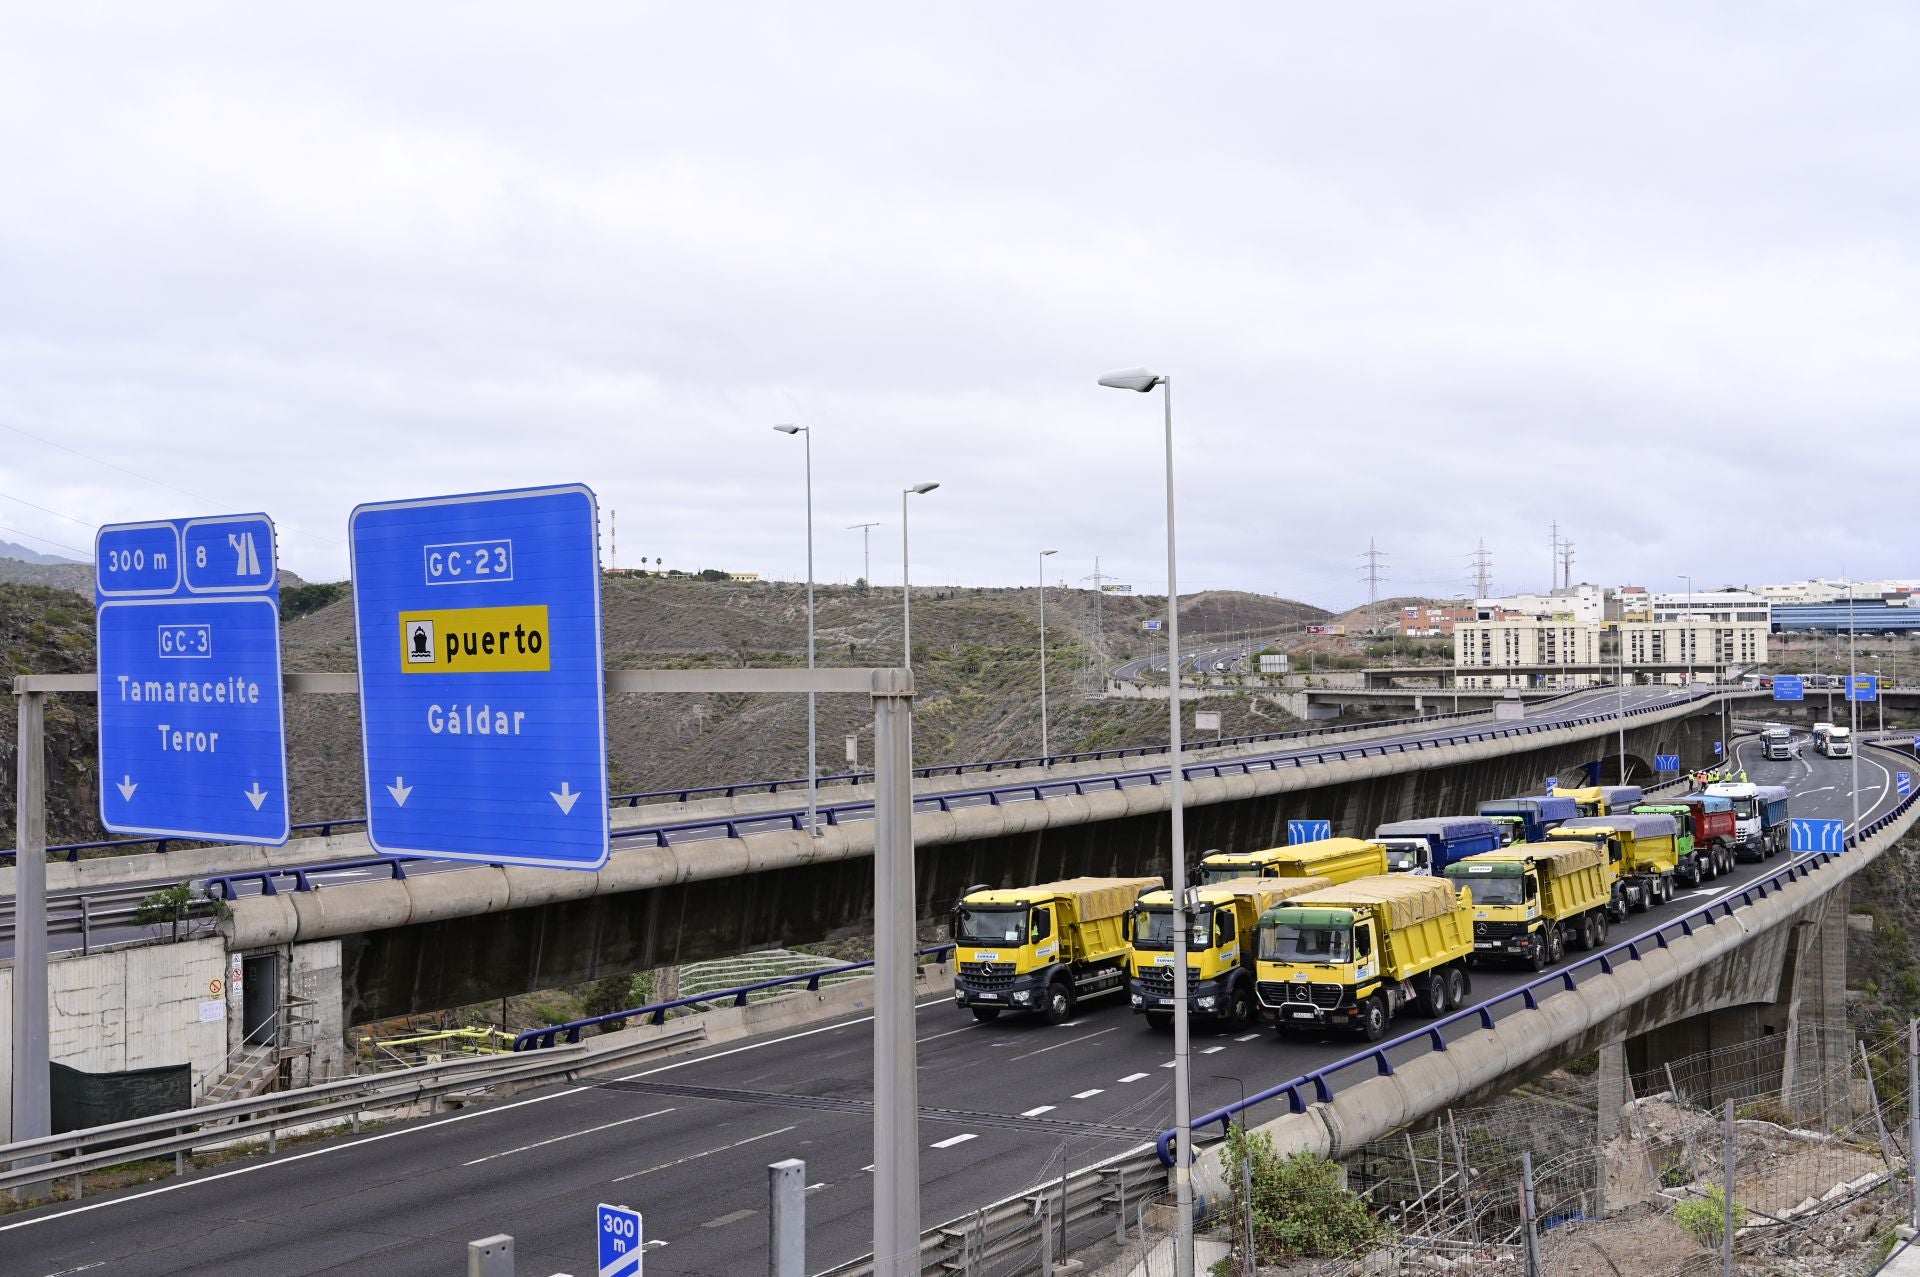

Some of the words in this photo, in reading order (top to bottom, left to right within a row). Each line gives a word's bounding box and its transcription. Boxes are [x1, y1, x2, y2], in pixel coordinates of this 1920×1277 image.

[109, 550, 144, 571] 300
[154, 553, 167, 570] m
[197, 546, 207, 568] 8
[430, 548, 508, 577] GC-23
[163, 630, 208, 652] GC-3
[447, 624, 542, 663] puerto
[118, 676, 259, 704] Tamaraceite
[428, 705, 525, 735] Gáldar
[159, 725, 219, 753] Teror
[604, 1214, 634, 1237] 300
[614, 1238, 626, 1254] m
